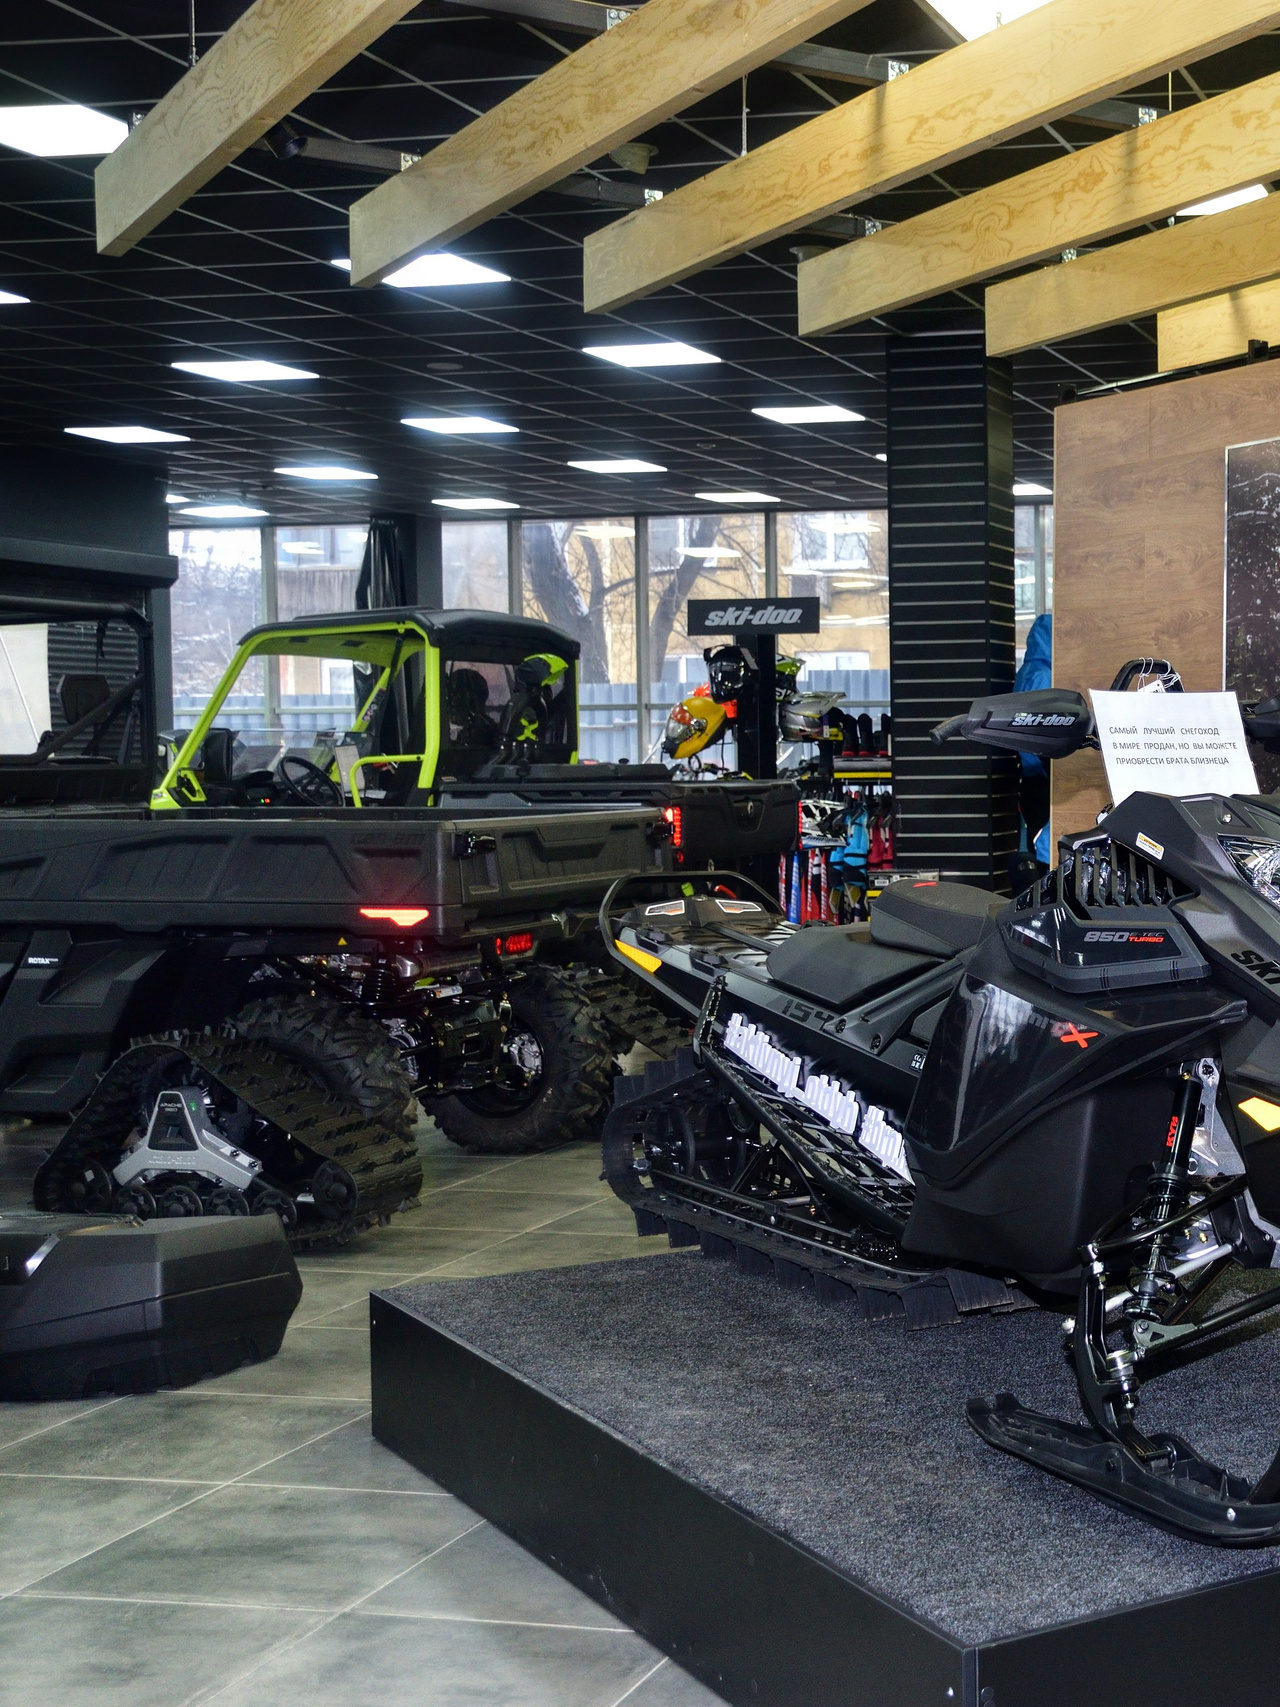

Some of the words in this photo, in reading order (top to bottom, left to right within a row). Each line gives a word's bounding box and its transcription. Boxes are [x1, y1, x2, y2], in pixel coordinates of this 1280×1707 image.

[705, 606, 803, 626] ski-doo
[1012, 714, 1075, 726] ski-doo
[1109, 726, 1138, 735] САМЫЙ
[1143, 726, 1176, 735] ЛУЧШИЙ
[1180, 727, 1220, 736] СНЕГОХОД
[1112, 742, 1118, 750] В
[1119, 742, 1141, 750] МИРЕ
[1143, 742, 1178, 751] ПРОДАН,
[1178, 742, 1190, 750] НО
[1193, 742, 1204, 750] ВЫ
[1116, 757, 1165, 765] ПРИОБРЕСТИ
[1166, 757, 1190, 765] БРАТА
[1190, 757, 1230, 766] БЛИЗНЕЦА
[1083, 931, 1130, 943] 850
